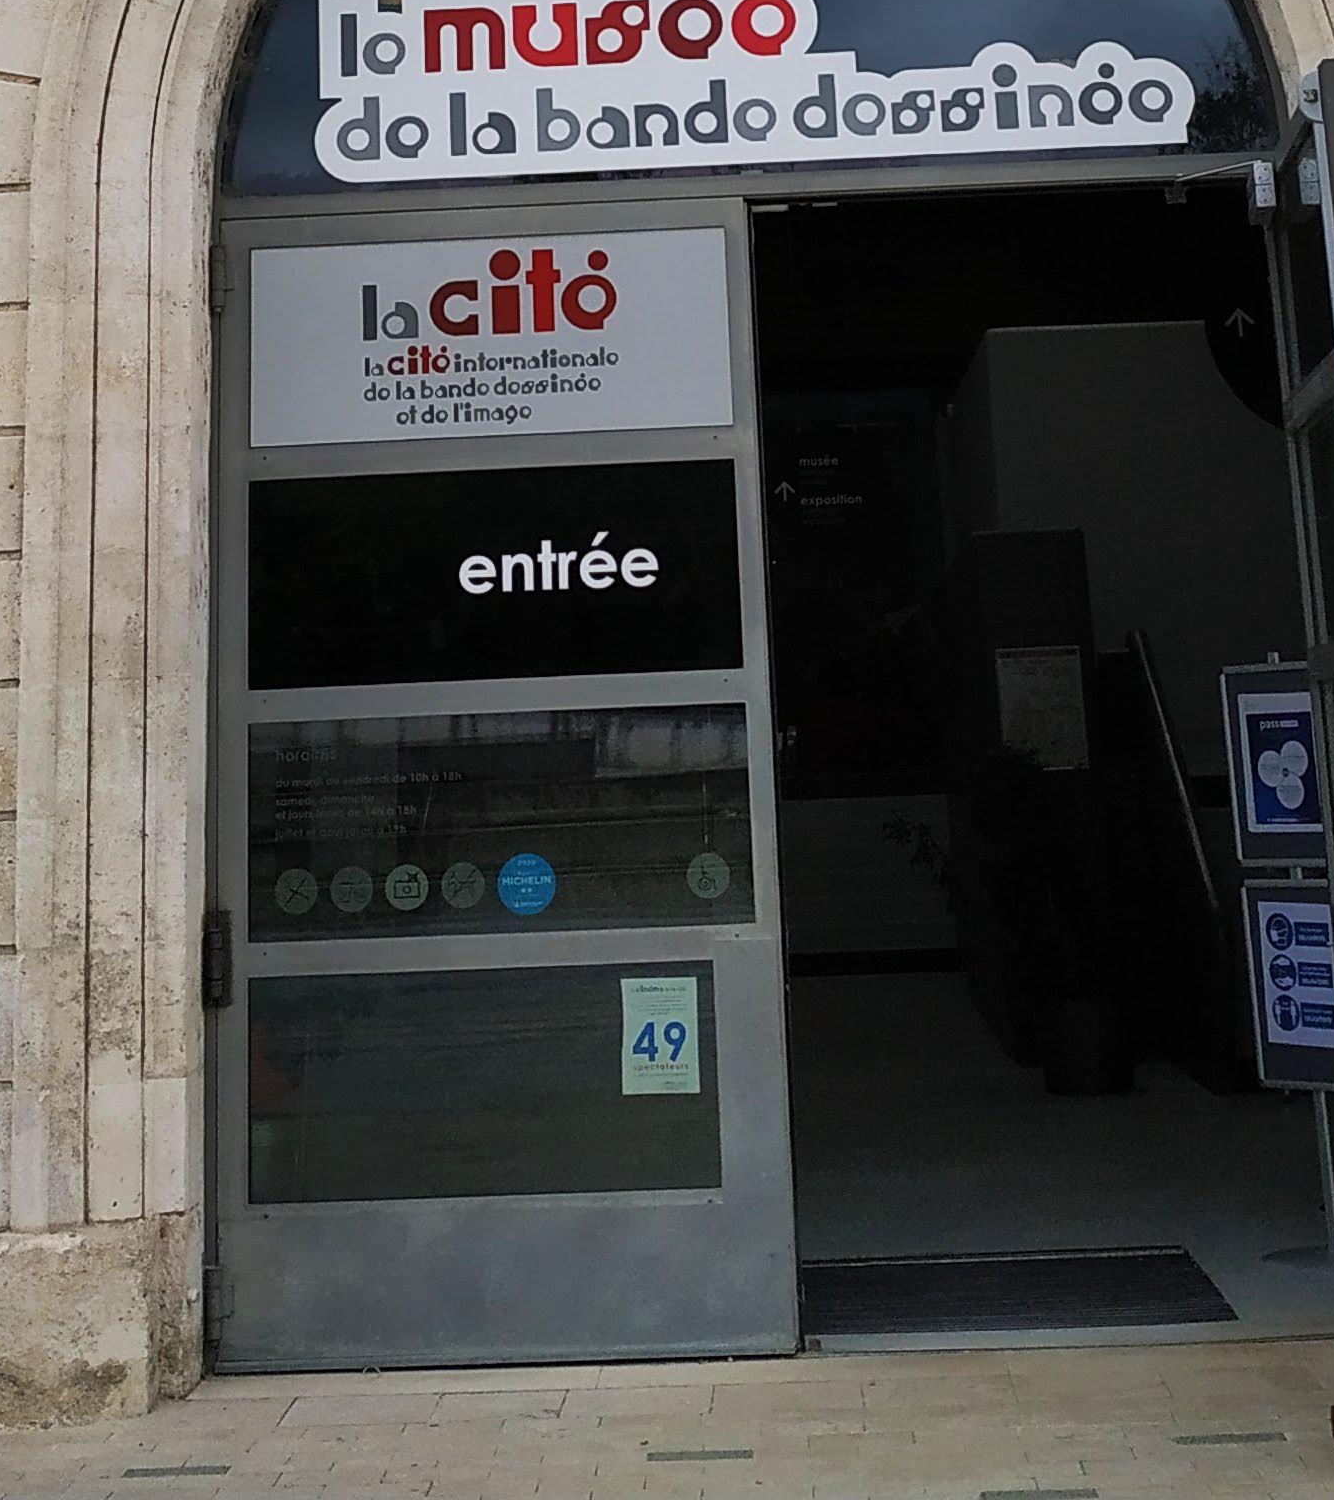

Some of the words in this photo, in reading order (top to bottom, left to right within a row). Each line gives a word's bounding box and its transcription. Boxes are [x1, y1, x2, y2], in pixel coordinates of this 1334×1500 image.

[451, 93, 516, 155] la
[363, 284, 418, 340] la
[365, 358, 384, 376] la
[396, 381, 415, 400] la
[800, 493, 863, 508] exposition
[459, 531, 660, 594] entrée
[410, 772, 429, 783] 10h
[502, 876, 552, 886] MICHELIN
[632, 1021, 687, 1063] 49
[633, 1063, 689, 1072] spectateurs
